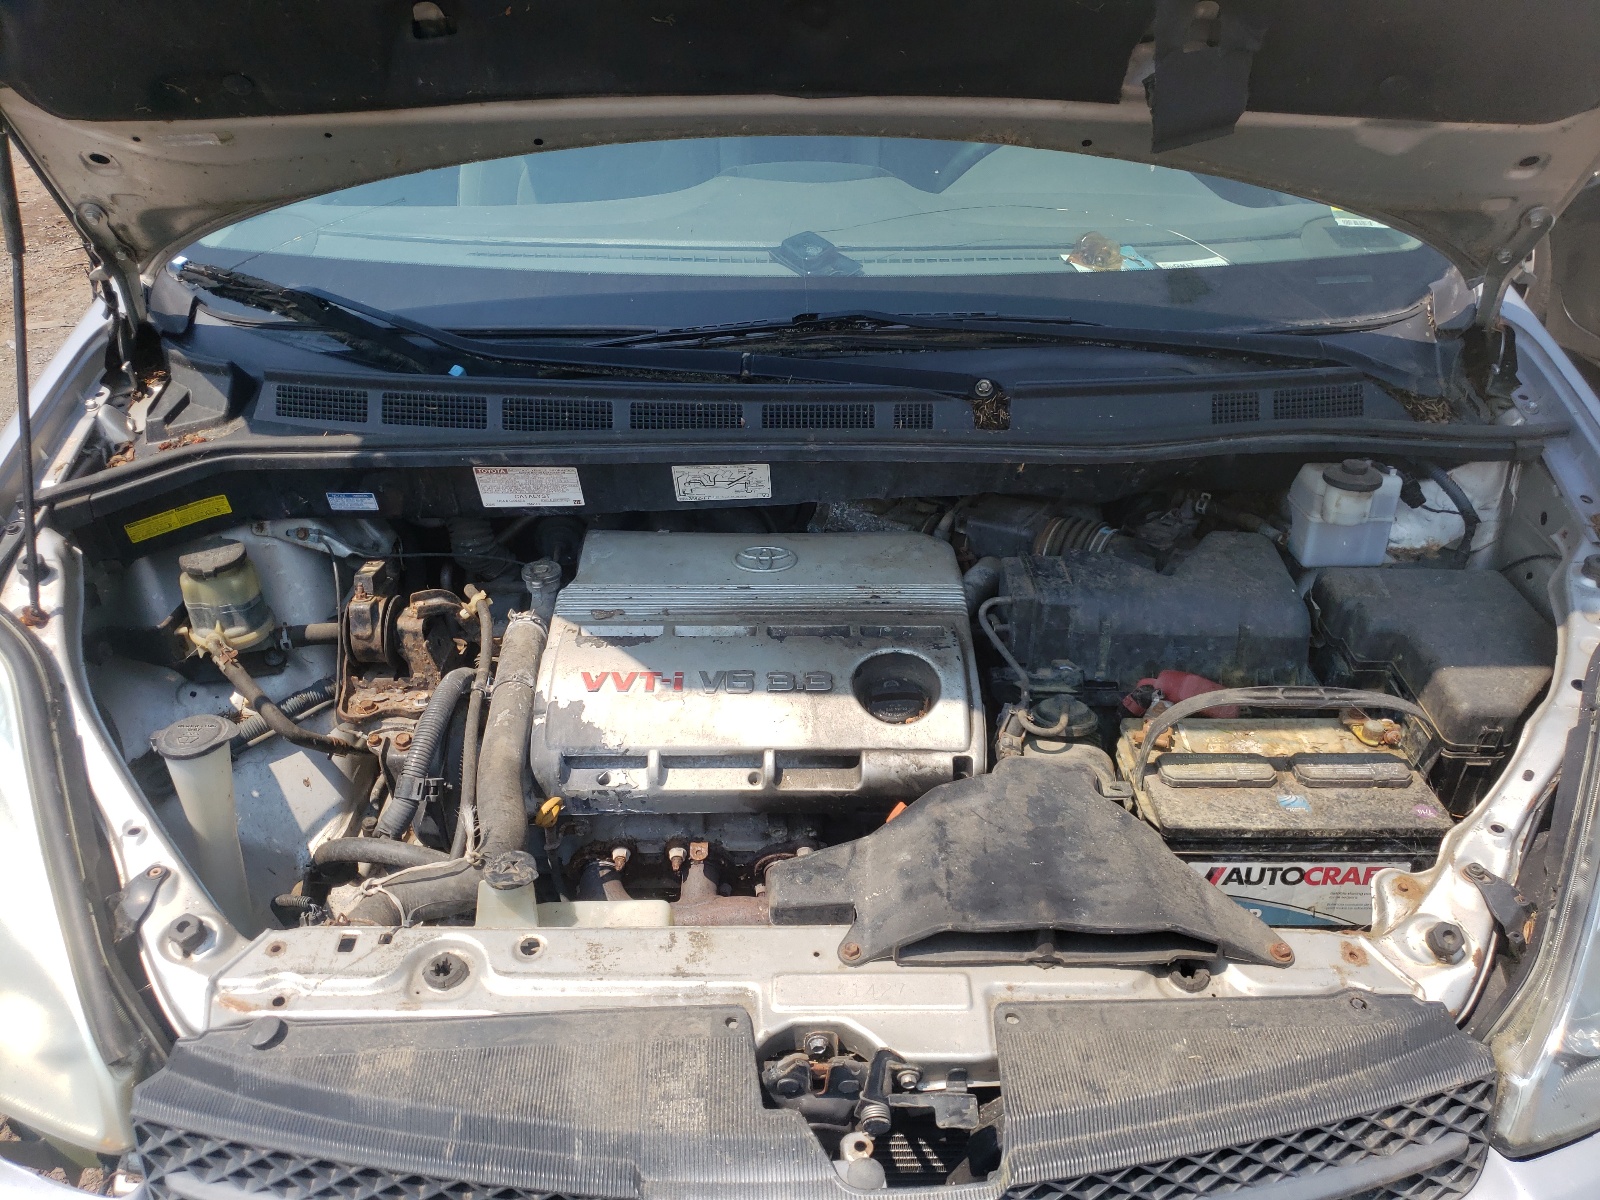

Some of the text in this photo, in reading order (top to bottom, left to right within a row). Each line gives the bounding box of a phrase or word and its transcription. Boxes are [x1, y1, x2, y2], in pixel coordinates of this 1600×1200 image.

[581, 670, 834, 694] VVT-i V6 3.3
[1221, 866, 1395, 886] AUTOCRAF
